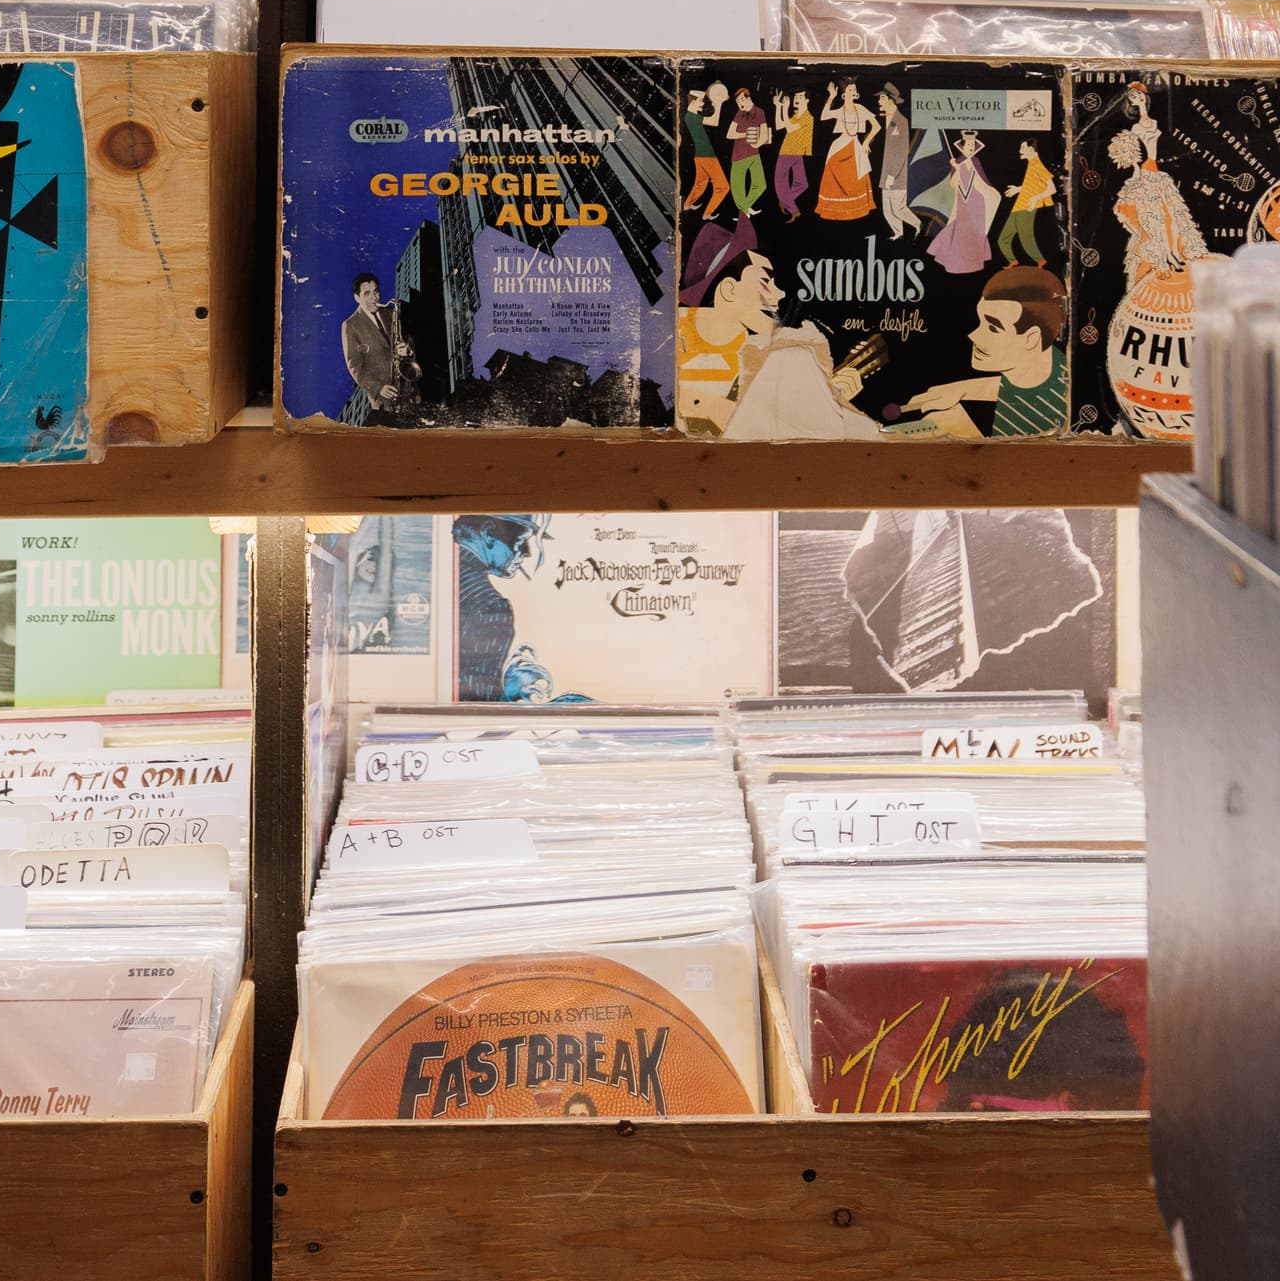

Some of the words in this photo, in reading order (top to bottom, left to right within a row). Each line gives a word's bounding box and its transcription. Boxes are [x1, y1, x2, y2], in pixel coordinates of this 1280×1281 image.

[915, 100, 943, 111] RCA
[945, 95, 1002, 112] VICTOR
[355, 122, 404, 136] CORAL
[423, 124, 616, 144] manhattan
[463, 152, 507, 165] tenor
[508, 154, 536, 165] sax
[538, 152, 578, 165] solos
[580, 152, 600, 168] by
[1172, 127, 1228, 172] TICO-TICO
[369, 173, 562, 197] GEORGIE
[495, 203, 608, 227] AULD
[1214, 227, 1244, 238] TABU
[537, 256, 612, 275] CONLON
[796, 235, 926, 303] sambas
[493, 276, 612, 294] RHYTHMAIRES
[841, 317, 871, 331] em
[878, 307, 928, 342] desfile
[21, 536, 79, 550] WORK!
[680, 555, 745, 587] Dunaway
[21, 559, 219, 609] THELONIOUS
[25, 611, 68, 625] sonny
[71, 610, 117, 623] rollins
[120, 608, 219, 657] MONK
[1035, 731, 1091, 747] SOUND
[442, 748, 483, 764] OST
[422, 826, 459, 841] OST
[915, 820, 960, 843] OST
[20, 856, 132, 888] ODETTA
[127, 967, 175, 978] STEREO
[434, 1013, 474, 1032] BILLY
[477, 1009, 552, 1029] PRESTON
[553, 1008, 563, 1022] &
[565, 1004, 634, 1022] SYREETA
[396, 1025, 671, 1120] FASTBREAK
[44, 1086, 92, 1117] Terry
